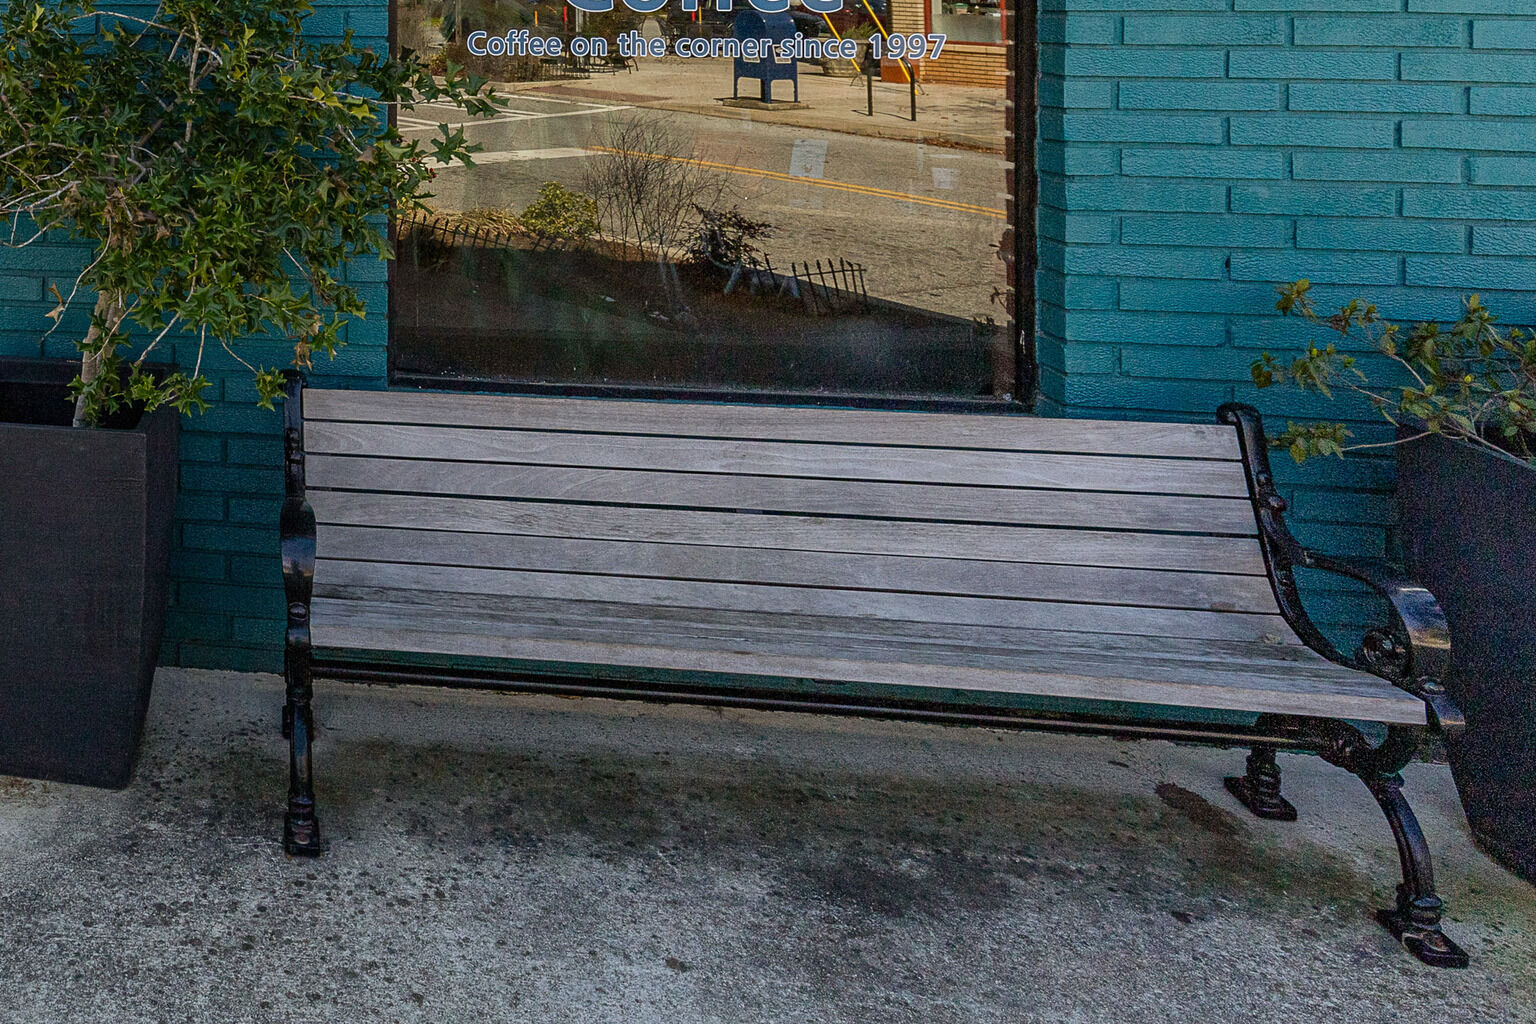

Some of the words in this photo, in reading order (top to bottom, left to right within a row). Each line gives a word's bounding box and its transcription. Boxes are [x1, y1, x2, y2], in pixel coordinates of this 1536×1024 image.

[467, 30, 562, 56] Coffee
[570, 36, 607, 56] on
[617, 30, 666, 57] the
[674, 37, 773, 58] corner
[779, 33, 857, 59] since
[868, 33, 946, 60] 1997
